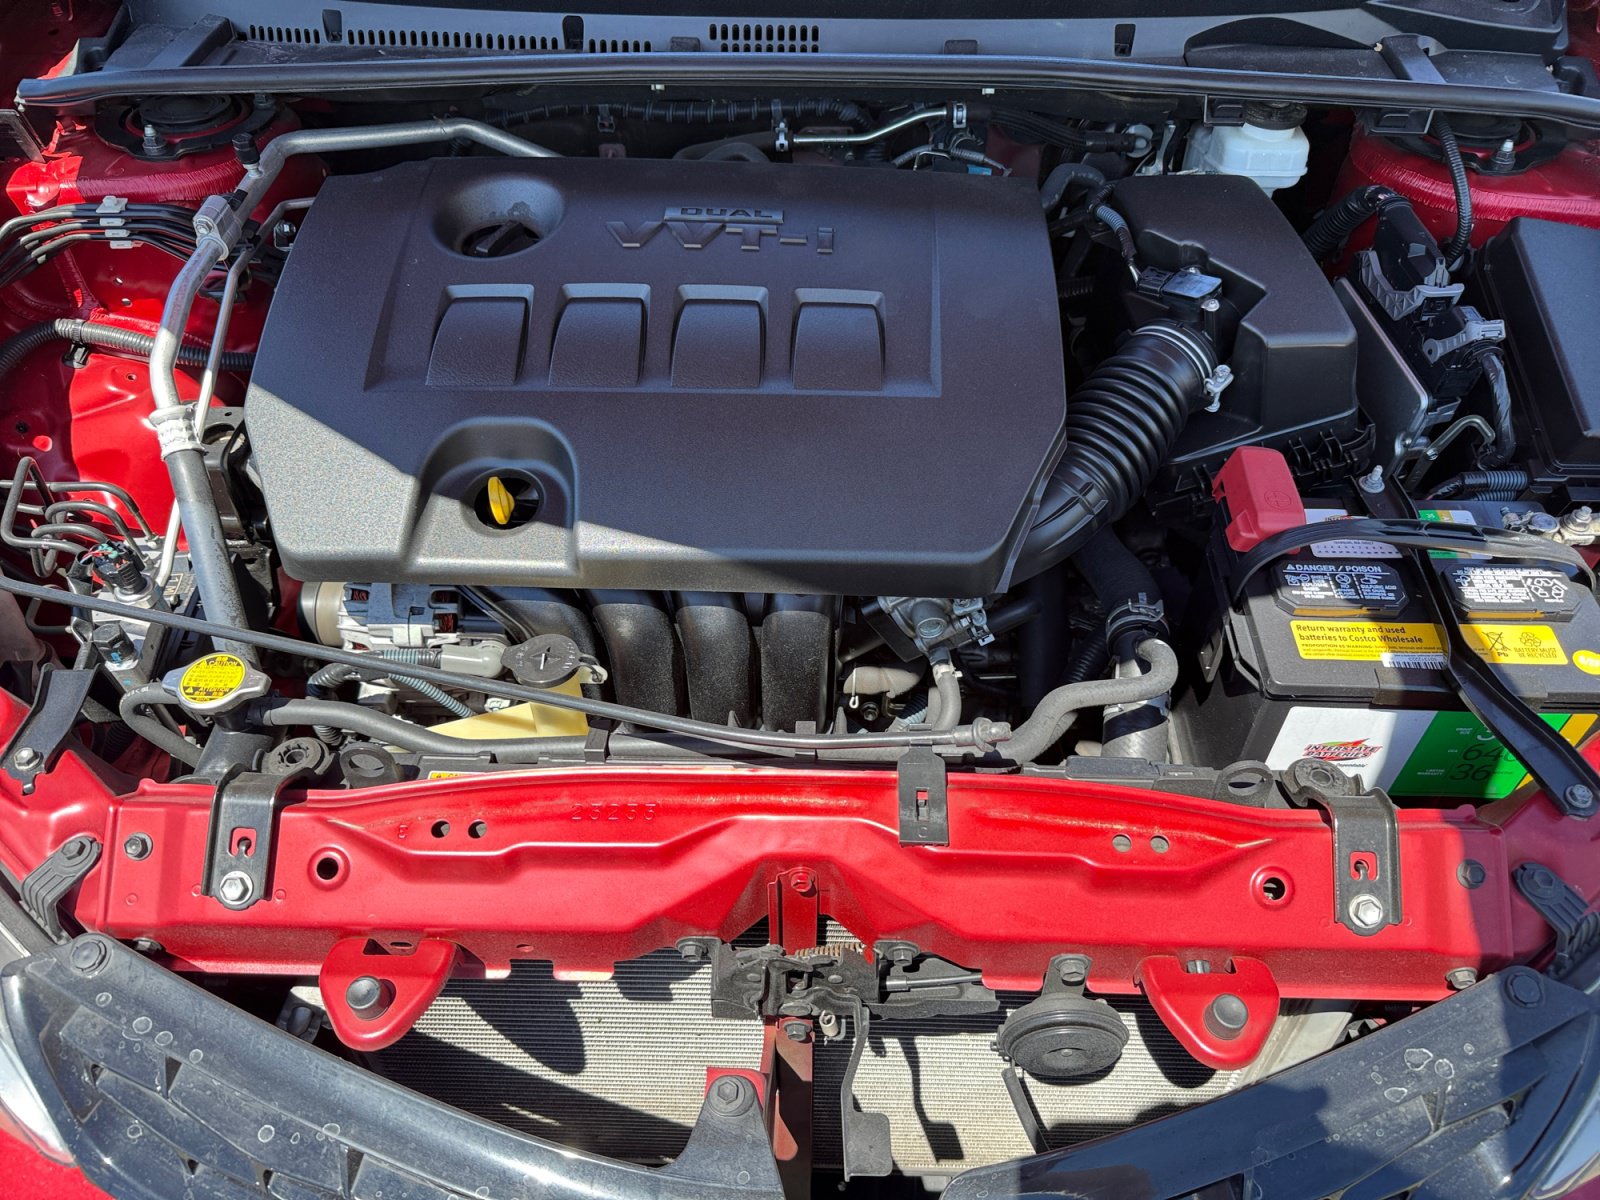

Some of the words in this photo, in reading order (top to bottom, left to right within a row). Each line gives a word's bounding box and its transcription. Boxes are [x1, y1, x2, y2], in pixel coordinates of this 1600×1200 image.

[680, 207, 773, 218] DUAL
[1295, 564, 1336, 572] DANGER
[1345, 565, 1382, 573] POISON
[1296, 624, 1326, 632] Return
[1328, 626, 1365, 634] warranty
[1384, 626, 1406, 634] used
[1299, 633, 1337, 642] batteries
[1338, 634, 1348, 642] to
[1348, 634, 1377, 643] Costco
[1378, 634, 1424, 643] Wholesale
[1305, 744, 1379, 752] INTERSTATE
[1449, 763, 1494, 781] 36
